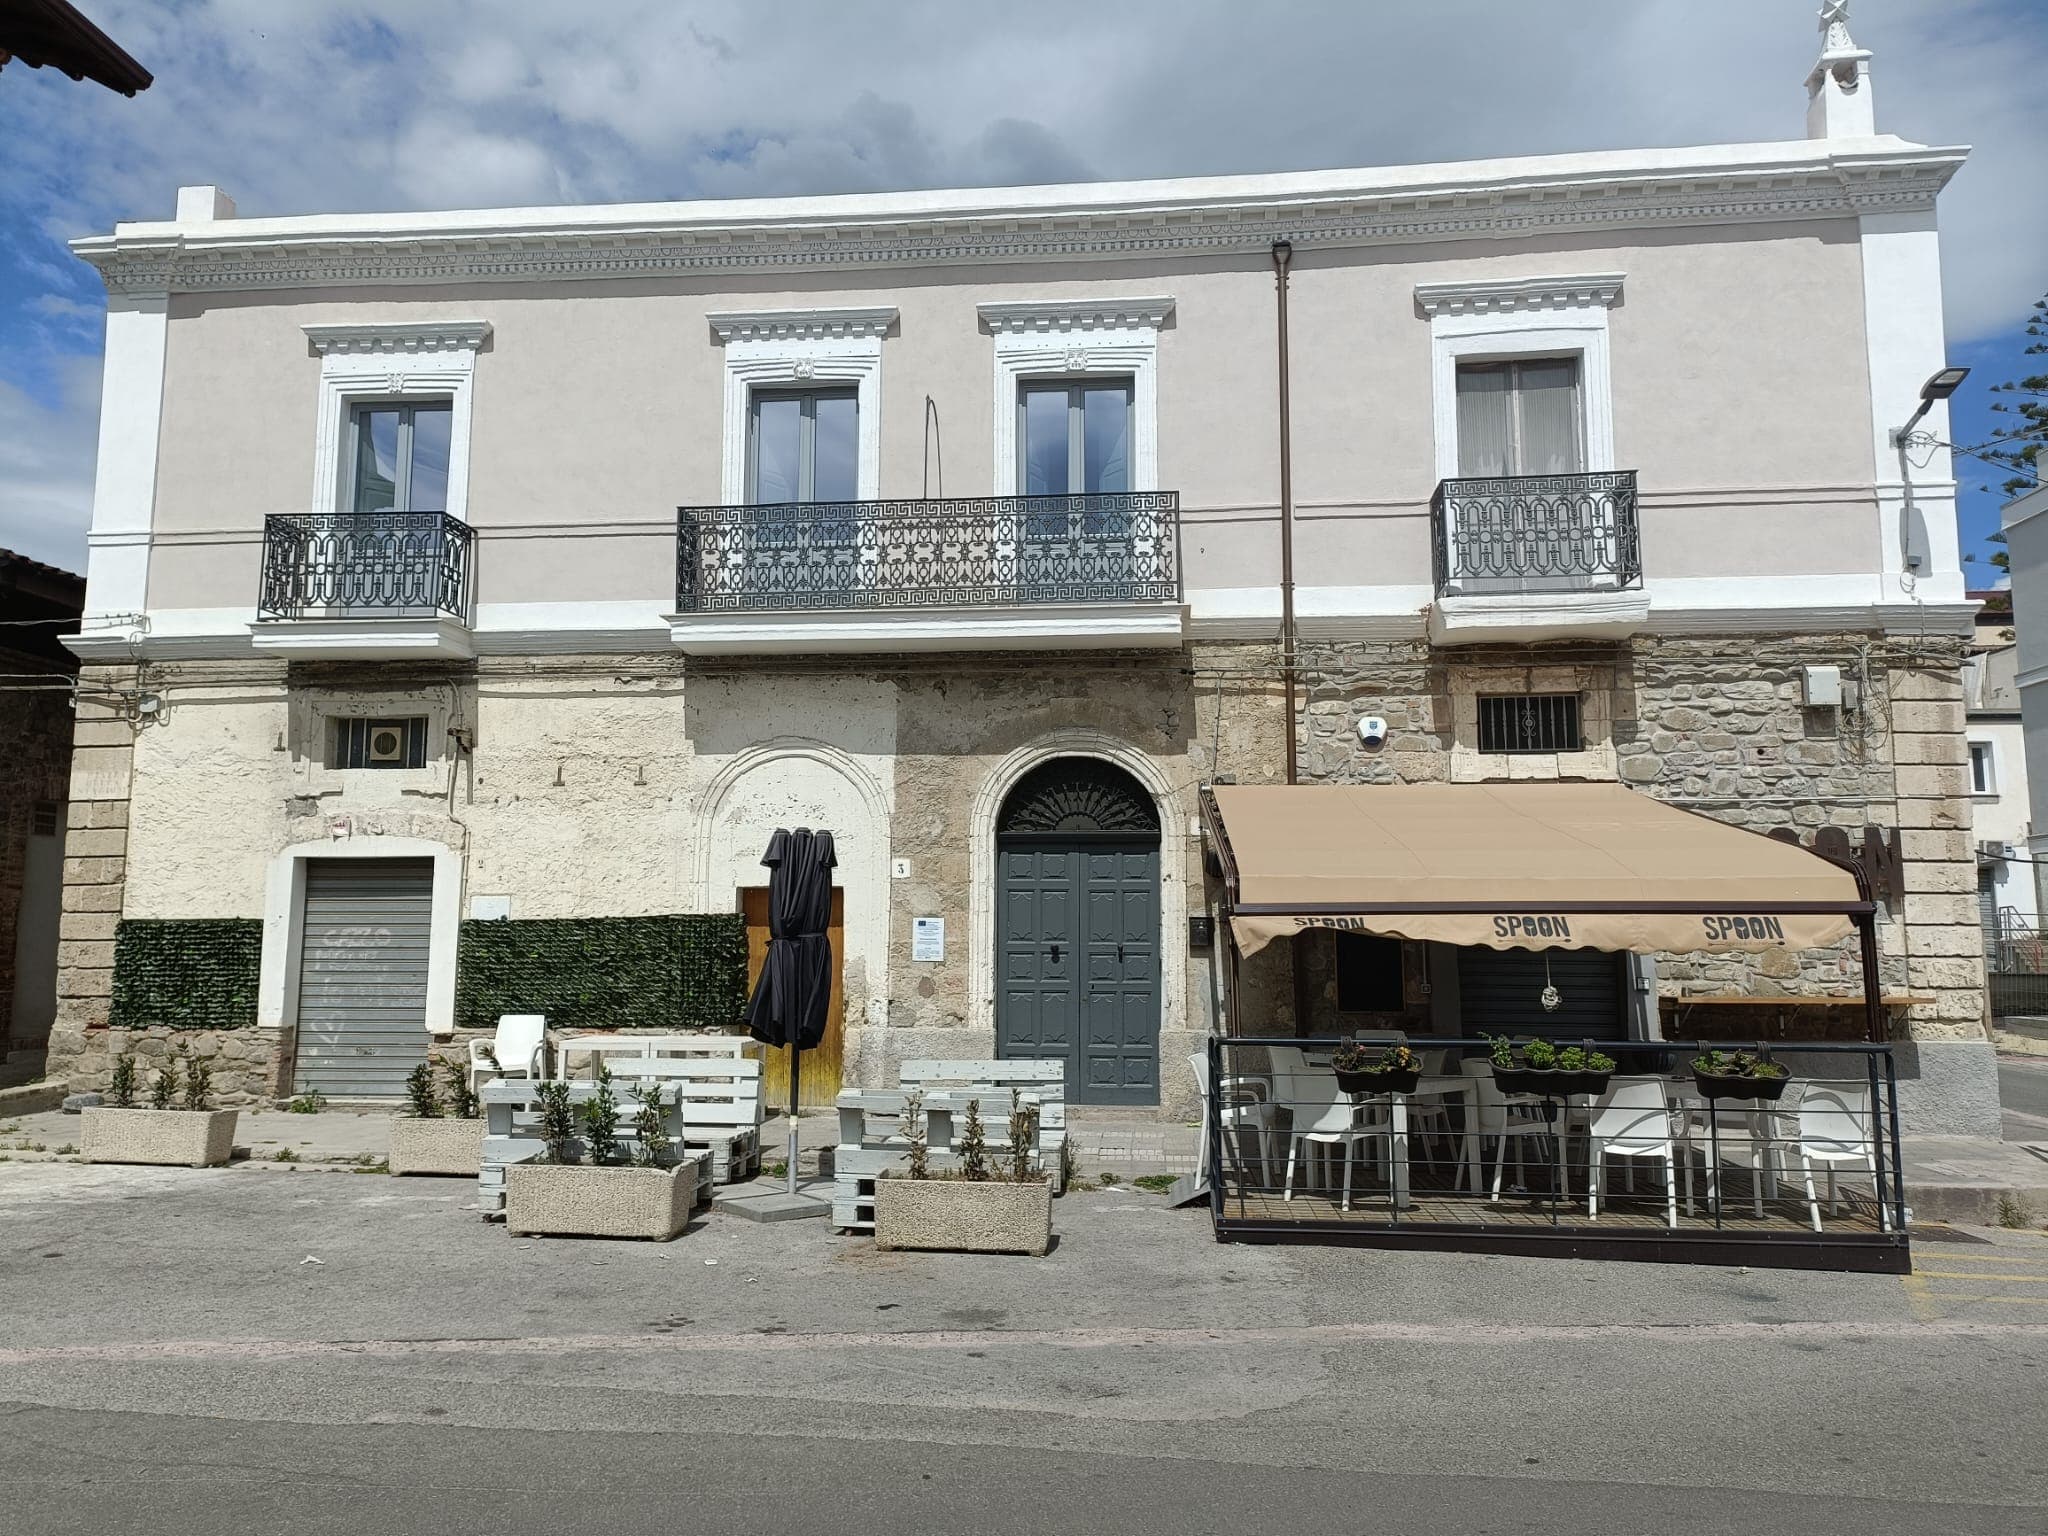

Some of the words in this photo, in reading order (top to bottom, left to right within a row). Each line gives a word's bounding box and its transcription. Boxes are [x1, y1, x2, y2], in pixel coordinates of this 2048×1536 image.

[1293, 917, 1365, 929] SPOON
[1493, 915, 1571, 937] SPOON
[1702, 916, 1784, 940] SPOON
